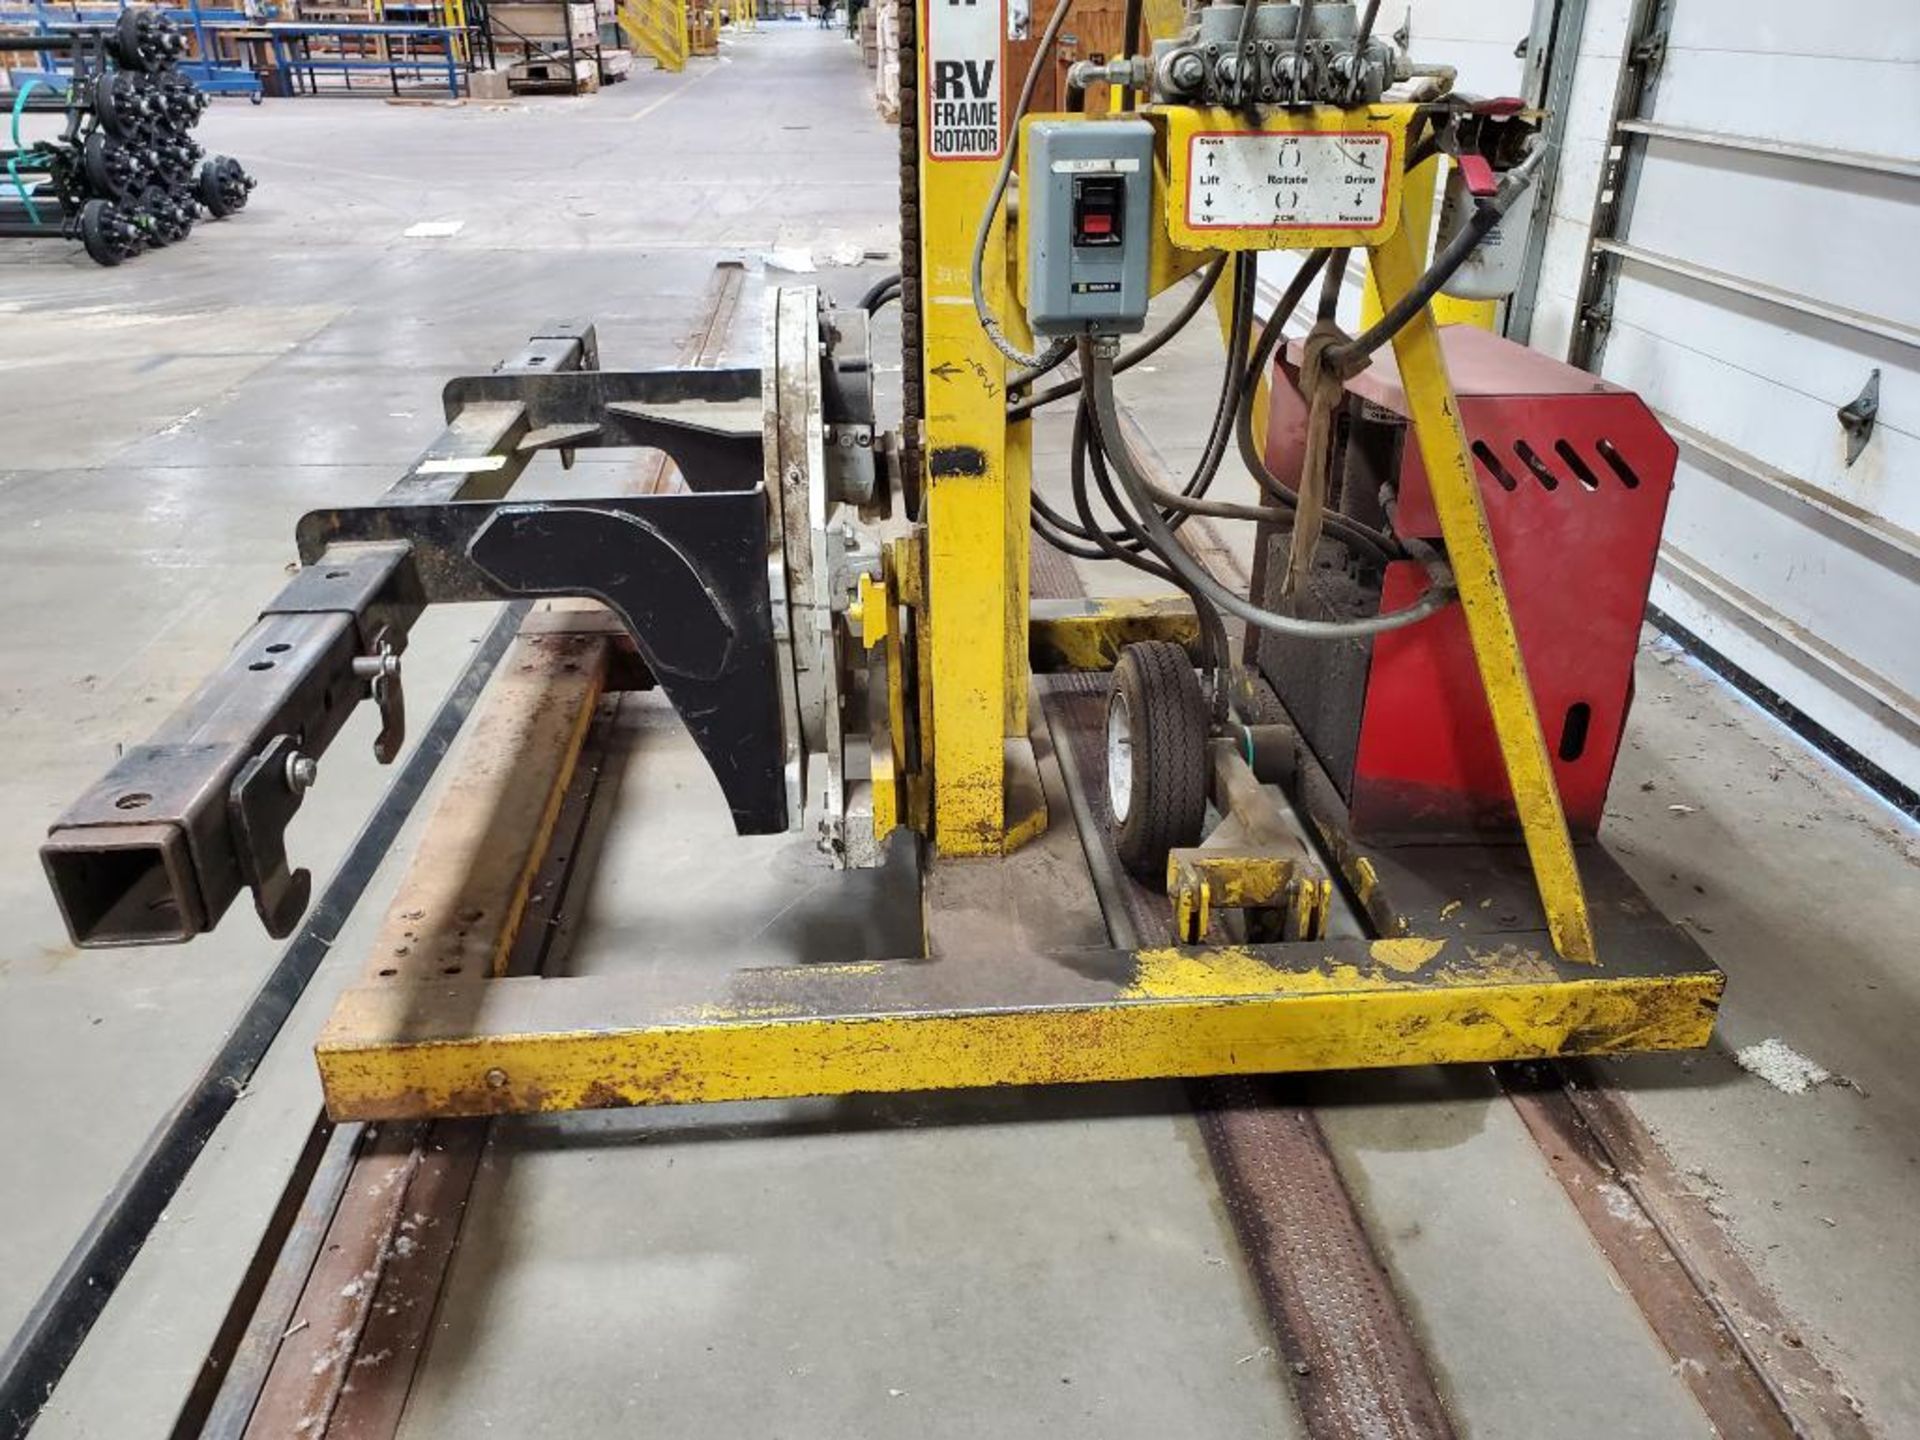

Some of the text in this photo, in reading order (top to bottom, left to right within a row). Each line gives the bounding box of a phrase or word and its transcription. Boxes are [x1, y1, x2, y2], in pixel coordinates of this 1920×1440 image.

[935, 60, 995, 99] RV
[934, 102, 997, 126] FRAME
[934, 128, 997, 153] ROTATOR
[1200, 175, 1220, 185] Lift
[1267, 175, 1308, 185] Rotate
[1344, 175, 1376, 185] Drive
